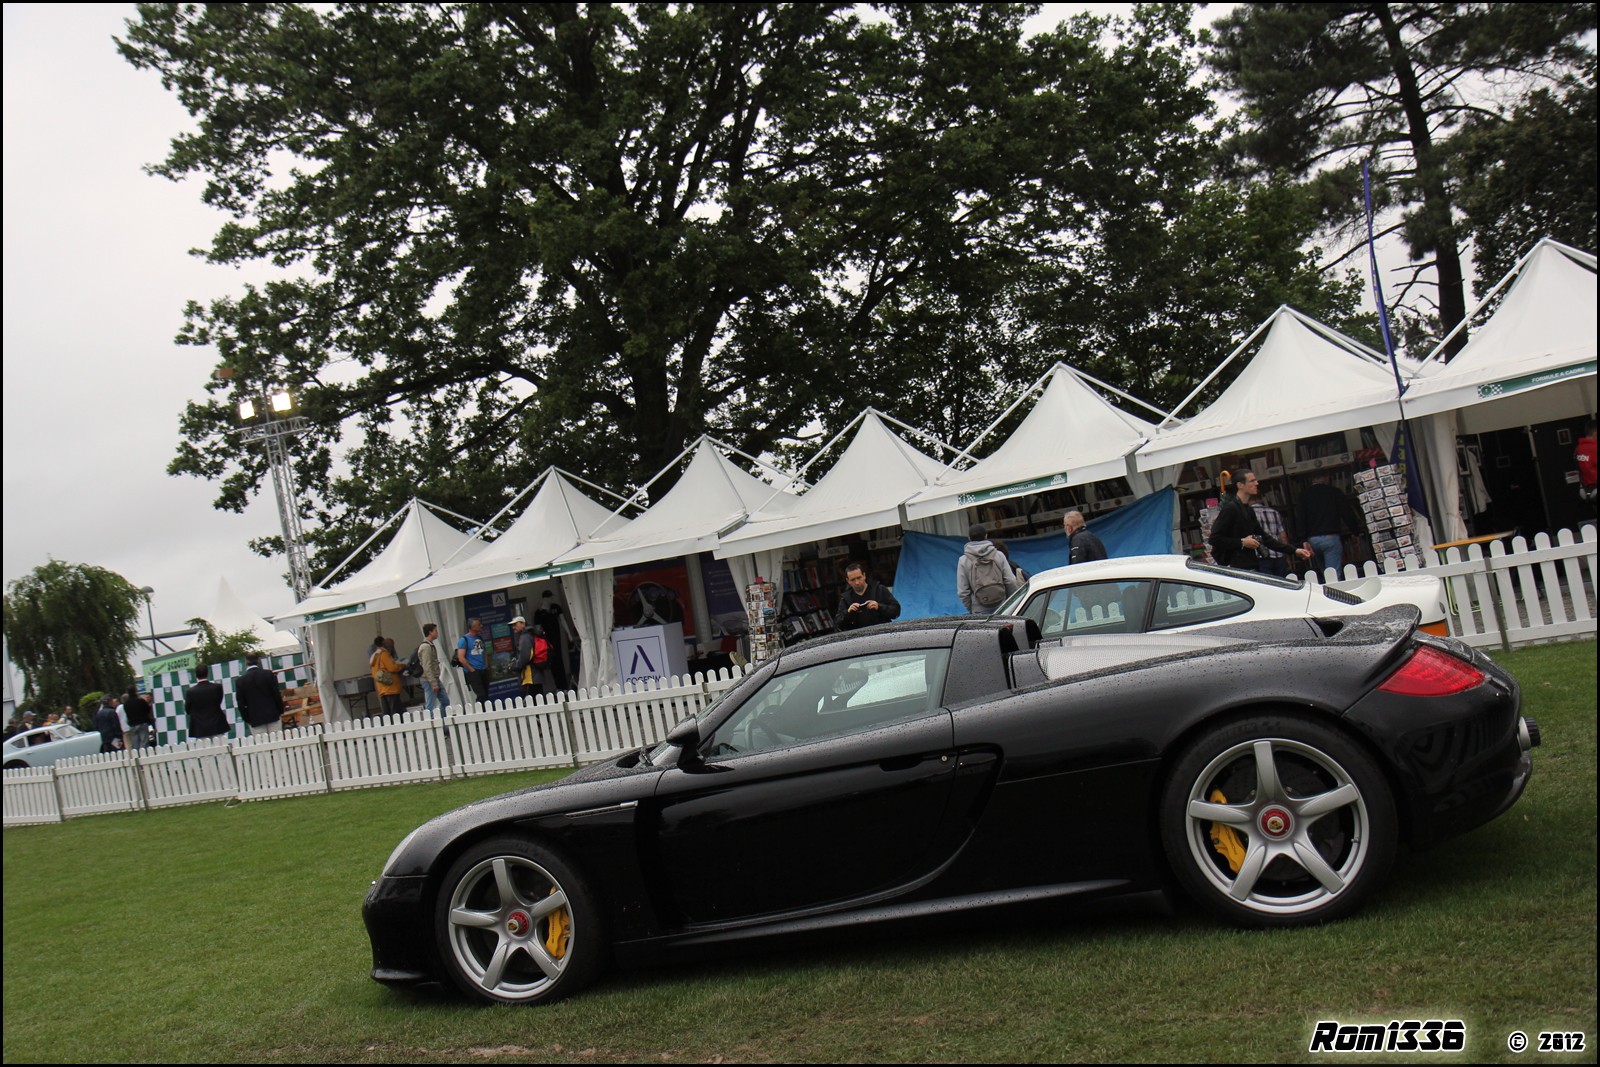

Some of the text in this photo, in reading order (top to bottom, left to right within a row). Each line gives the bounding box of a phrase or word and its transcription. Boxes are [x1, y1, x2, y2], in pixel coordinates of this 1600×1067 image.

[1532, 373, 1559, 383] FORMULE
[1565, 367, 1586, 376] CADRE
[990, 482, 1037, 497] CHATERS BOOKSELLERS
